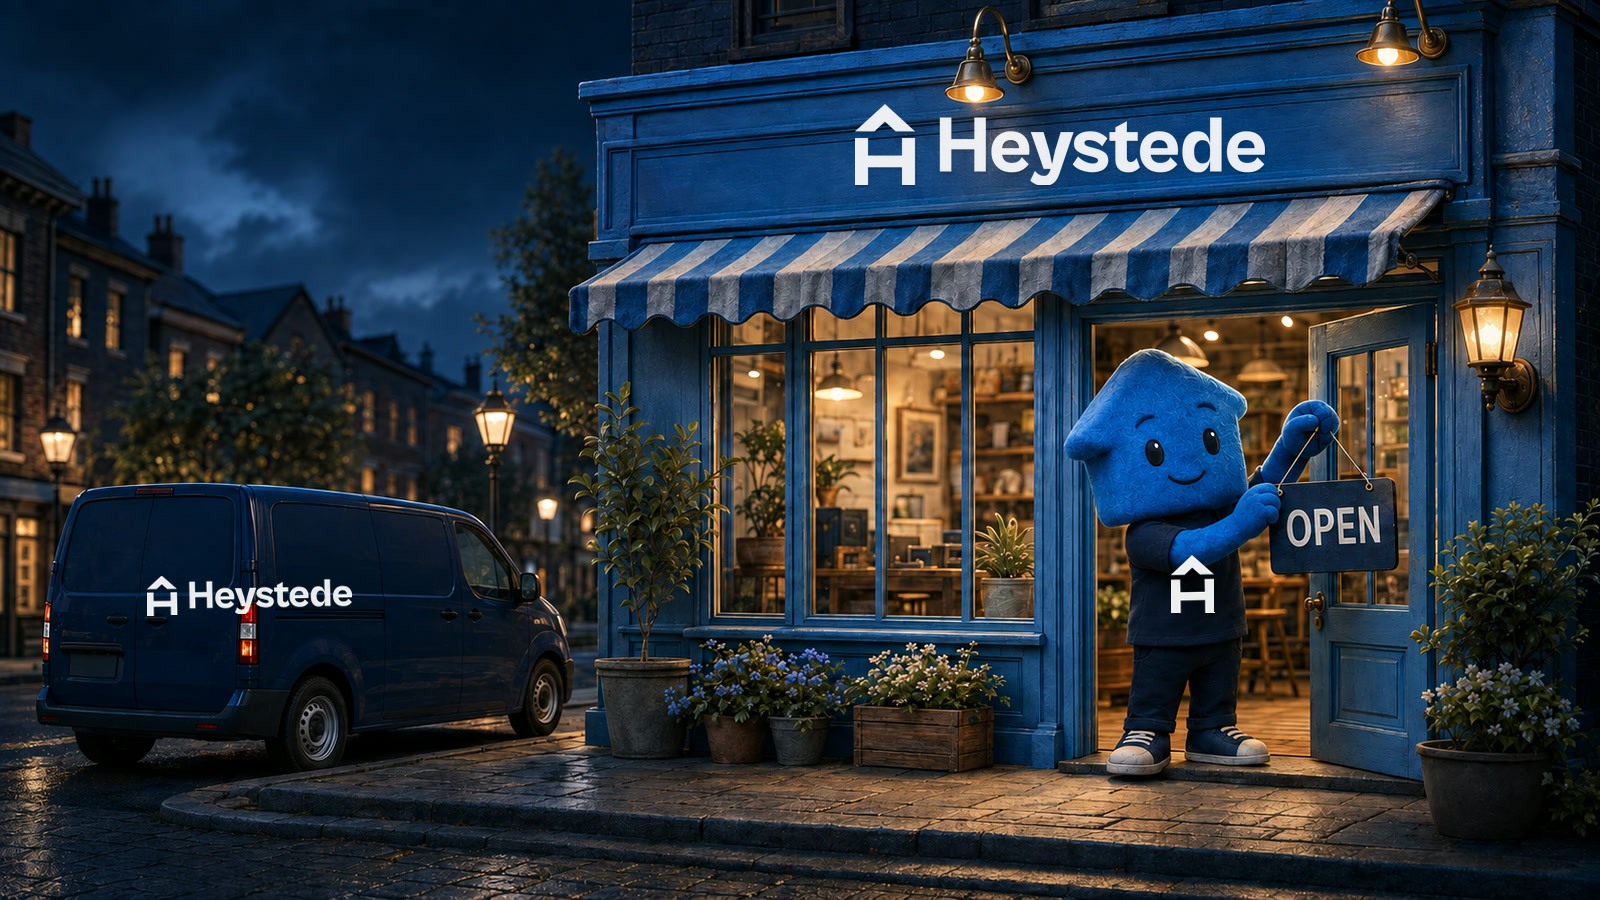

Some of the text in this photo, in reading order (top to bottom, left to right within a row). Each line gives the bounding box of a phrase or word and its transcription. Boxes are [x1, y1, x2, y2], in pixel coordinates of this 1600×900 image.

[940, 117, 1266, 186] Heystede
[1287, 506, 1381, 547] OPEN
[189, 580, 352, 614] Heystede
